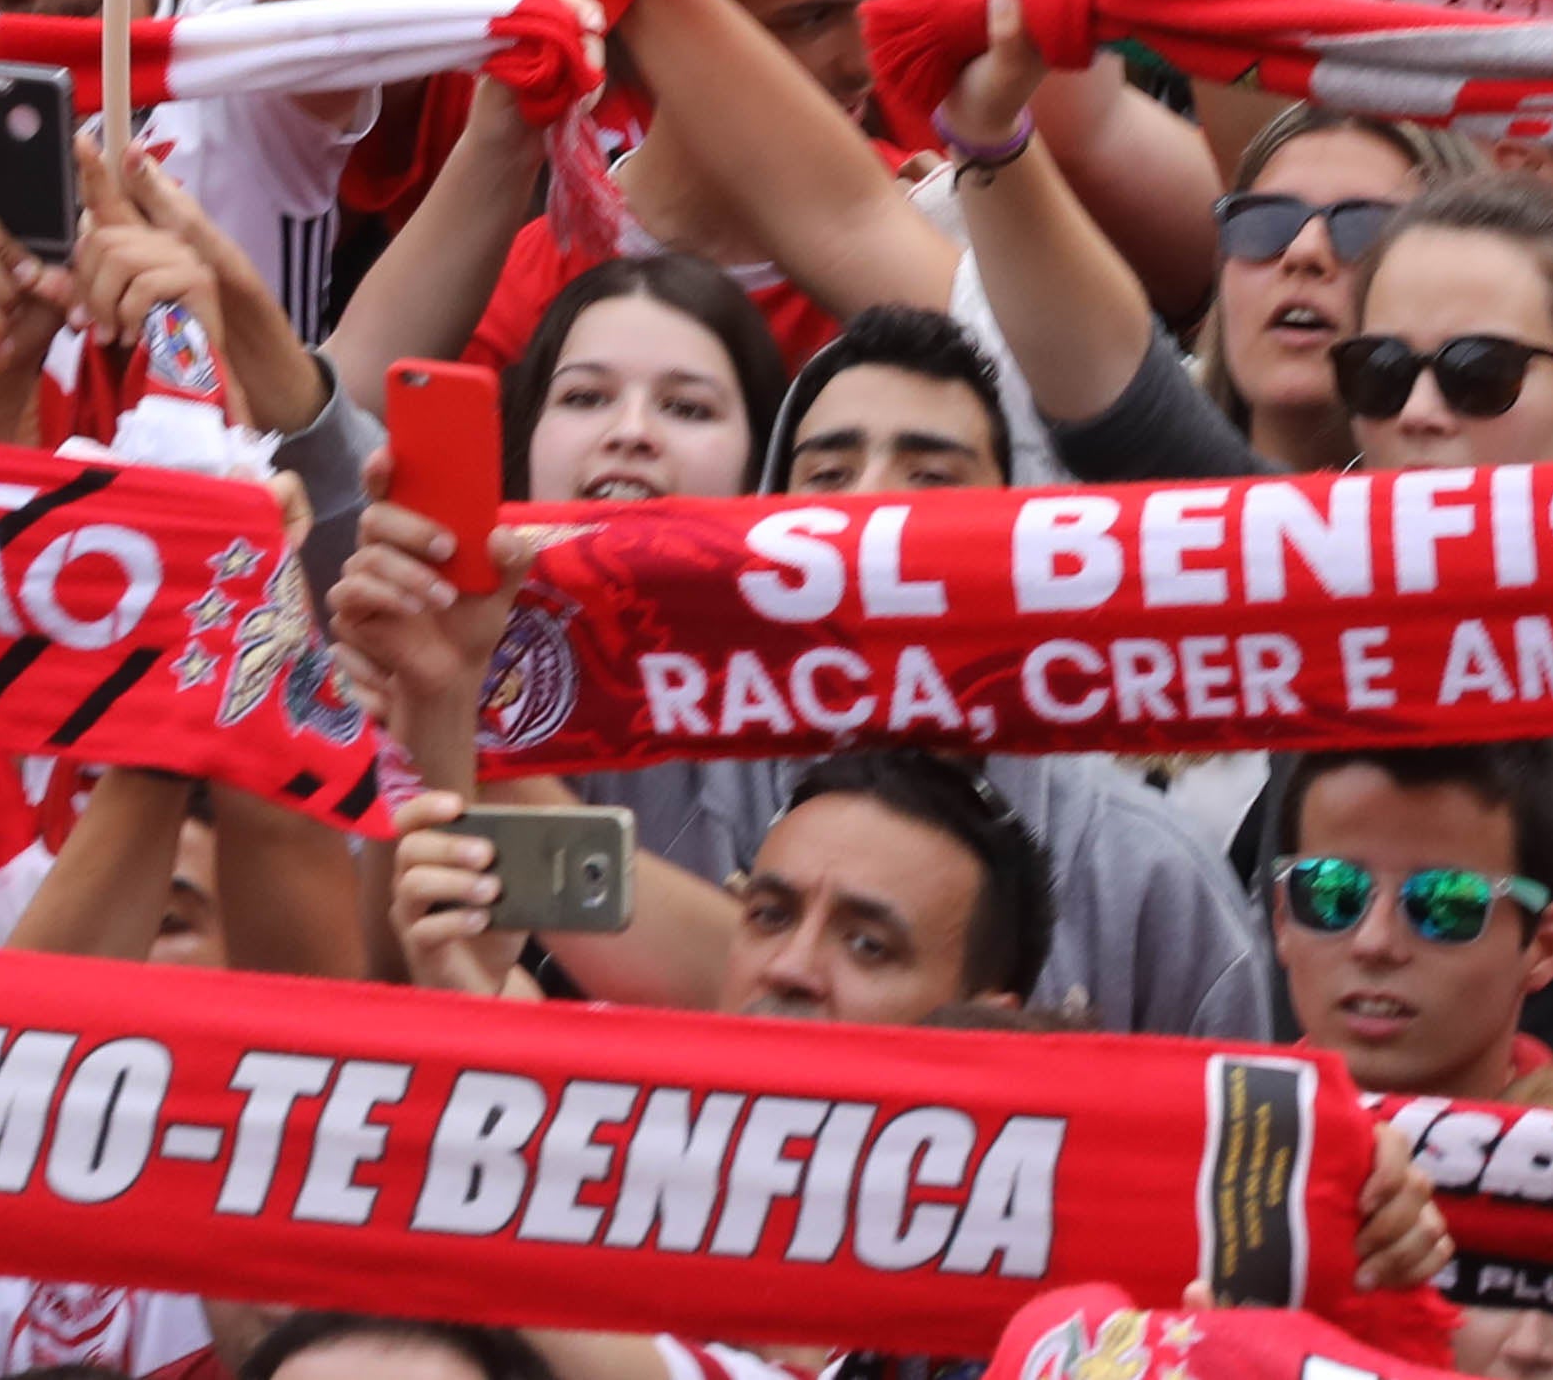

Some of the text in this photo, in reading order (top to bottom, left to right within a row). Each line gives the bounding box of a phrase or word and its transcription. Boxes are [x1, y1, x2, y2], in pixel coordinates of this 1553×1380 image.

[736, 505, 949, 625] SL
[1021, 629, 1306, 727] CRER
[1339, 625, 1398, 713] E
[409, 1067, 1069, 1282] BENFICA
